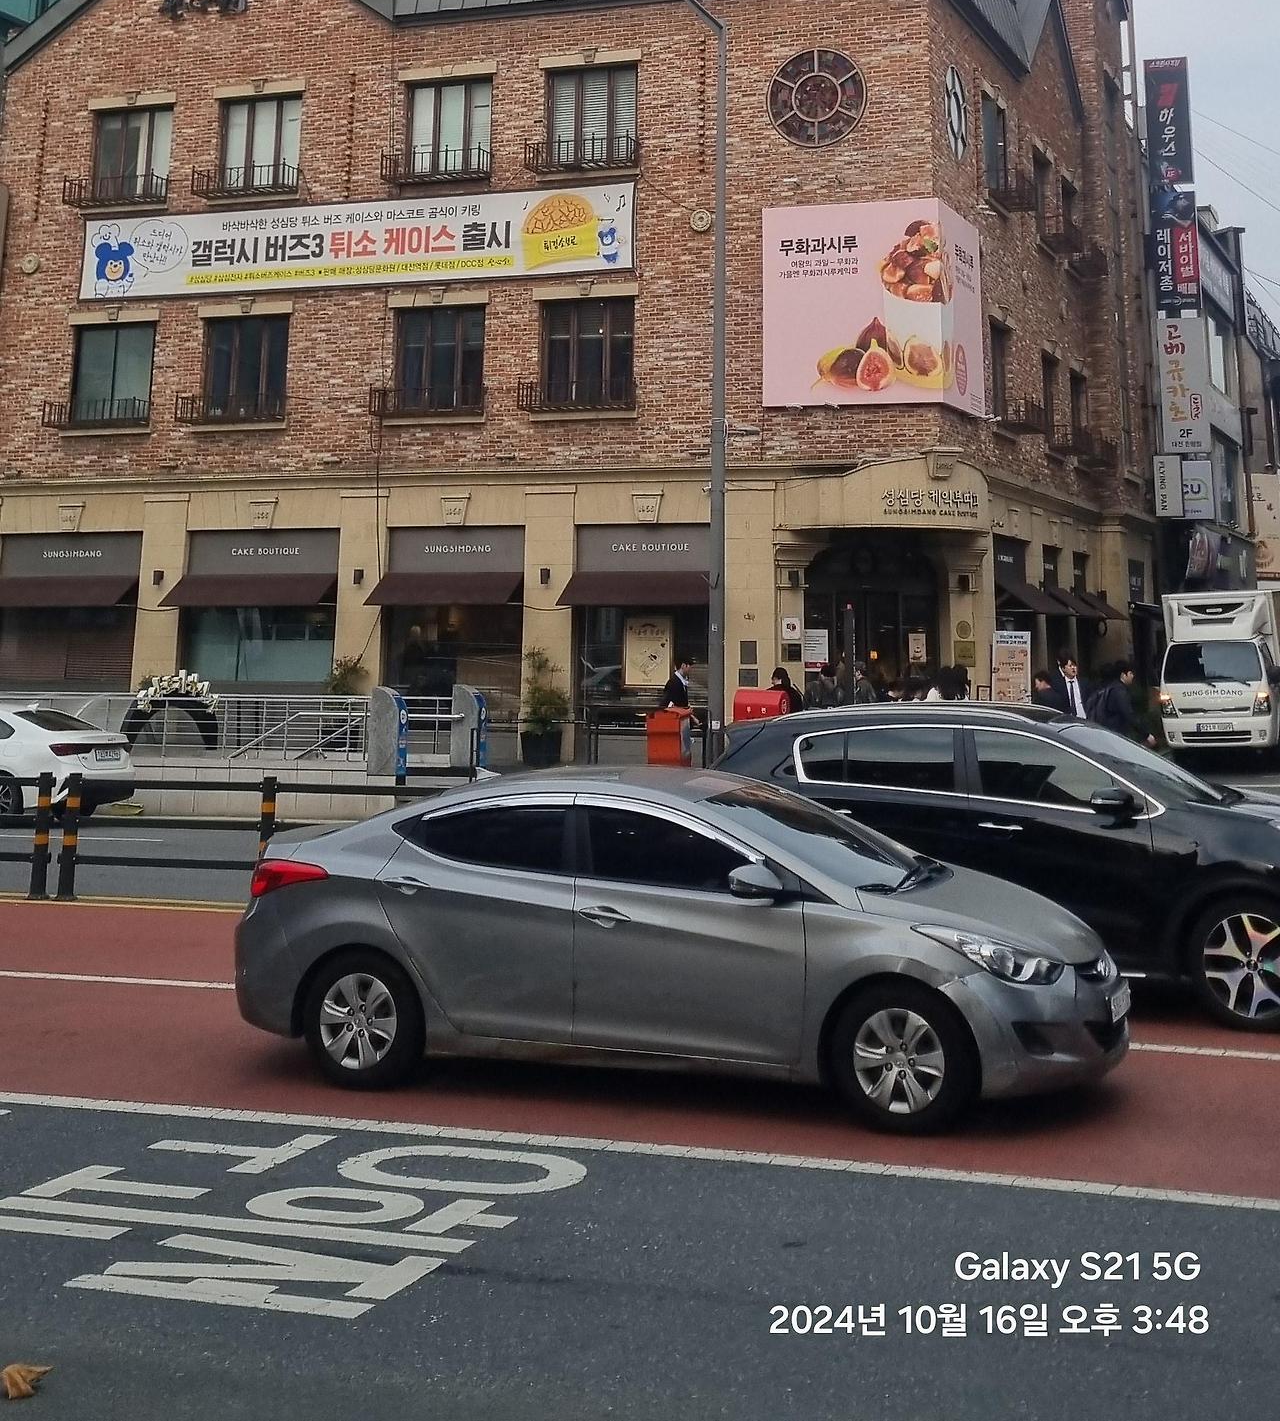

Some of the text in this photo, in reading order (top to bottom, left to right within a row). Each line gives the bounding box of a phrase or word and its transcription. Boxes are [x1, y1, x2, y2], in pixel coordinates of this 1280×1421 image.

[222, 203, 481, 232] 바삭바삭한 성심당 튀소 버즈 케이스와 마스코트 곰식이 키링
[149, 229, 172, 240] 드디어
[191, 220, 511, 267] 갤럭시 버즈3 튀소 케이스 출시
[779, 235, 858, 256] 무화과시루
[837, 257, 859, 266] 무화과
[1156, 228, 1173, 291] 레이저총
[1179, 231, 1194, 278] 서바이벌
[1179, 428, 1193, 438] 2F
[1158, 460, 1166, 490] FLYING
[881, 488, 925, 507] 성심당
[42, 549, 103, 559] SUNGSIMDANG
[231, 546, 300, 556] CAKE BOUTIQUE
[424, 544, 492, 554] SUNGSIMDANG
[611, 541, 690, 553] CAKE BOUTIQUE
